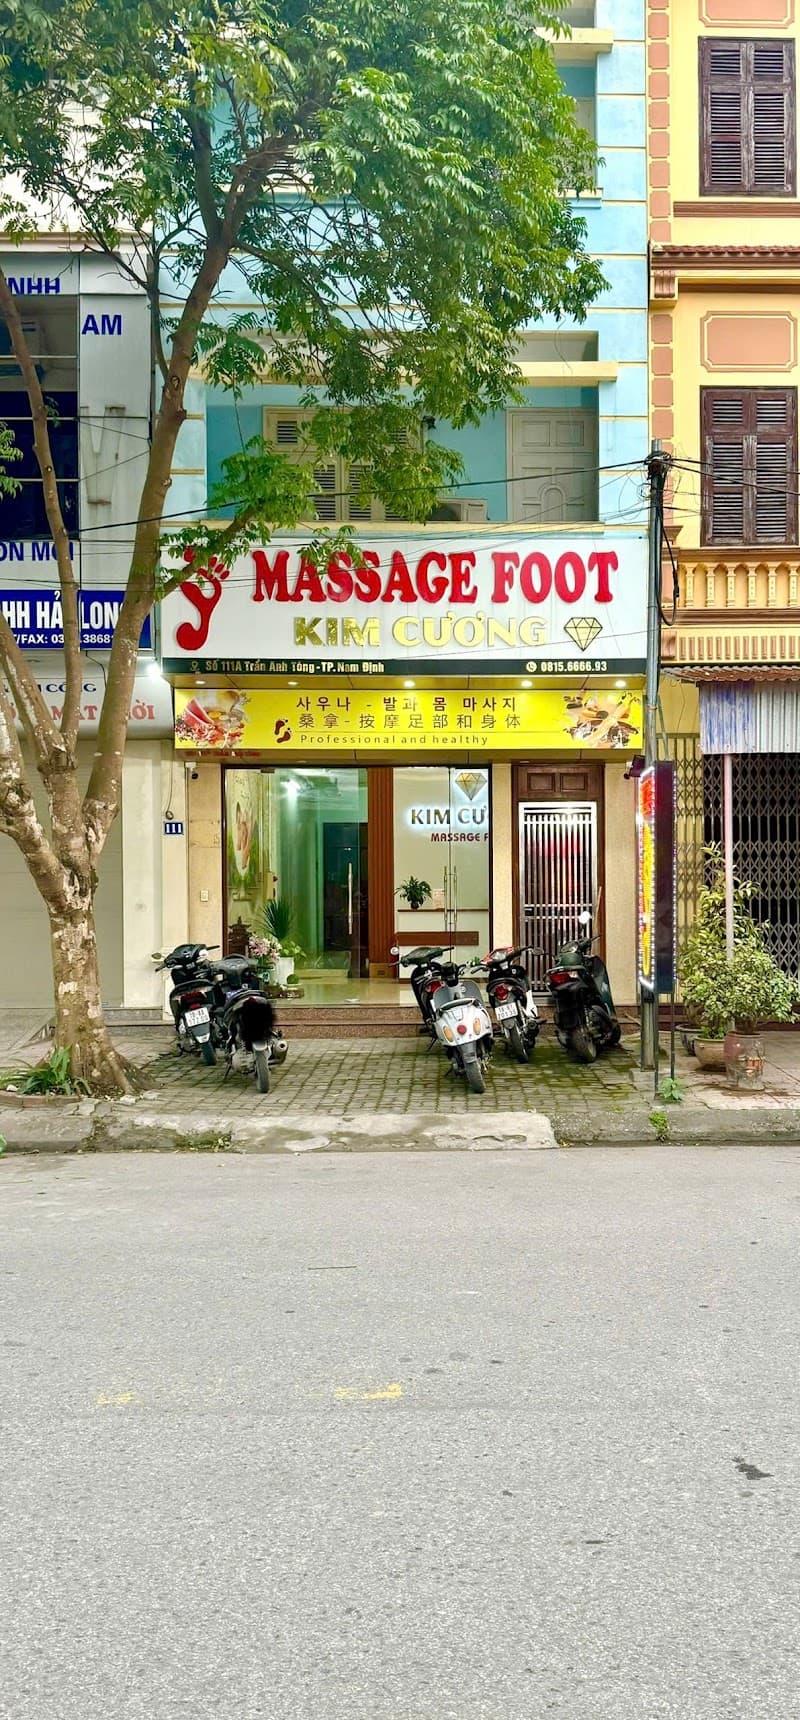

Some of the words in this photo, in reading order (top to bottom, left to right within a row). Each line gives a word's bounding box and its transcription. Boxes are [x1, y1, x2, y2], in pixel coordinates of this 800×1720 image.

[5, 277, 61, 295] NHH
[252, 550, 478, 604] MASSAGE
[491, 551, 619, 604] FOOT
[36, 590, 64, 629] HẢ
[81, 601, 124, 630] LON
[294, 616, 381, 647] KIM
[392, 611, 548, 647] CƯƠNG
[221, 660, 243, 672] 111A
[269, 660, 288, 672] Anh
[362, 661, 385, 674] Định
[540, 660, 608, 672] 0815.6666.93
[296, 696, 351, 712] 사우나
[383, 696, 418, 712] 발과
[432, 696, 447, 712] 몸
[463, 696, 516, 712] 마사지
[300, 734, 395, 744] Professional
[401, 734, 427, 744] and
[432, 734, 489, 746] healthy
[411, 808, 451, 825] KIM
[457, 804, 489, 825] CƯ
[166, 823, 182, 834] 111
[431, 832, 481, 842] MASSAGE
